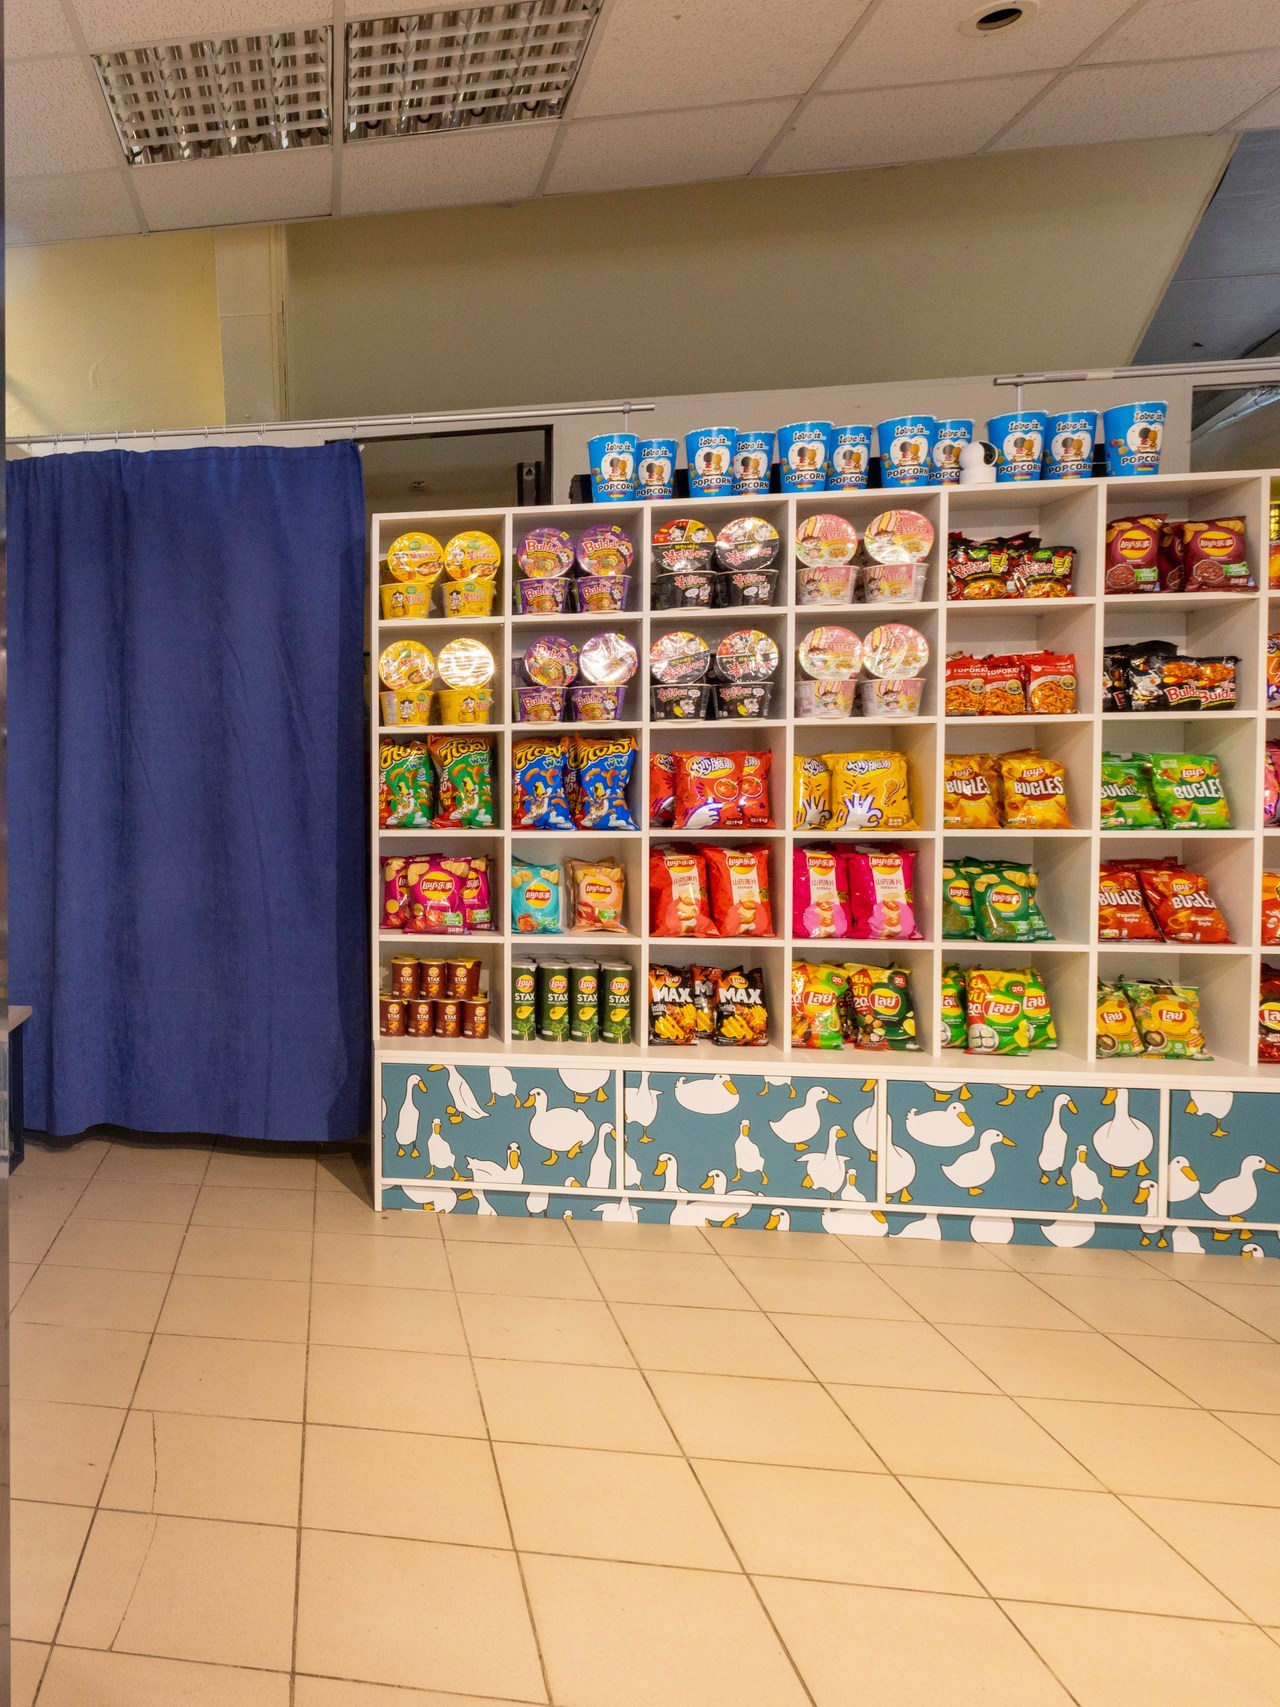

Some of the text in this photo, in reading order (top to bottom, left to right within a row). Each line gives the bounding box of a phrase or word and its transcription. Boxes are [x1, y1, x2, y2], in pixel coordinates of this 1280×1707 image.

[888, 467, 928, 478] POPCORN
[1000, 463, 1041, 473] POPCORN
[1049, 463, 1091, 473] POPCORN
[693, 477, 731, 487] POPCORN
[786, 472, 825, 482] POPCORN
[599, 481, 633, 492] POPCORN
[732, 481, 769, 491] POPCORN
[636, 487, 672, 496] POPCORN
[1014, 776, 1064, 795] BUGLES
[514, 993, 535, 1001] STAX
[548, 993, 568, 1001] STAX
[577, 994, 598, 1002] STAX
[609, 995, 630, 1003] STAX
[651, 987, 693, 1003] MAX
[718, 988, 763, 1004] MAX
